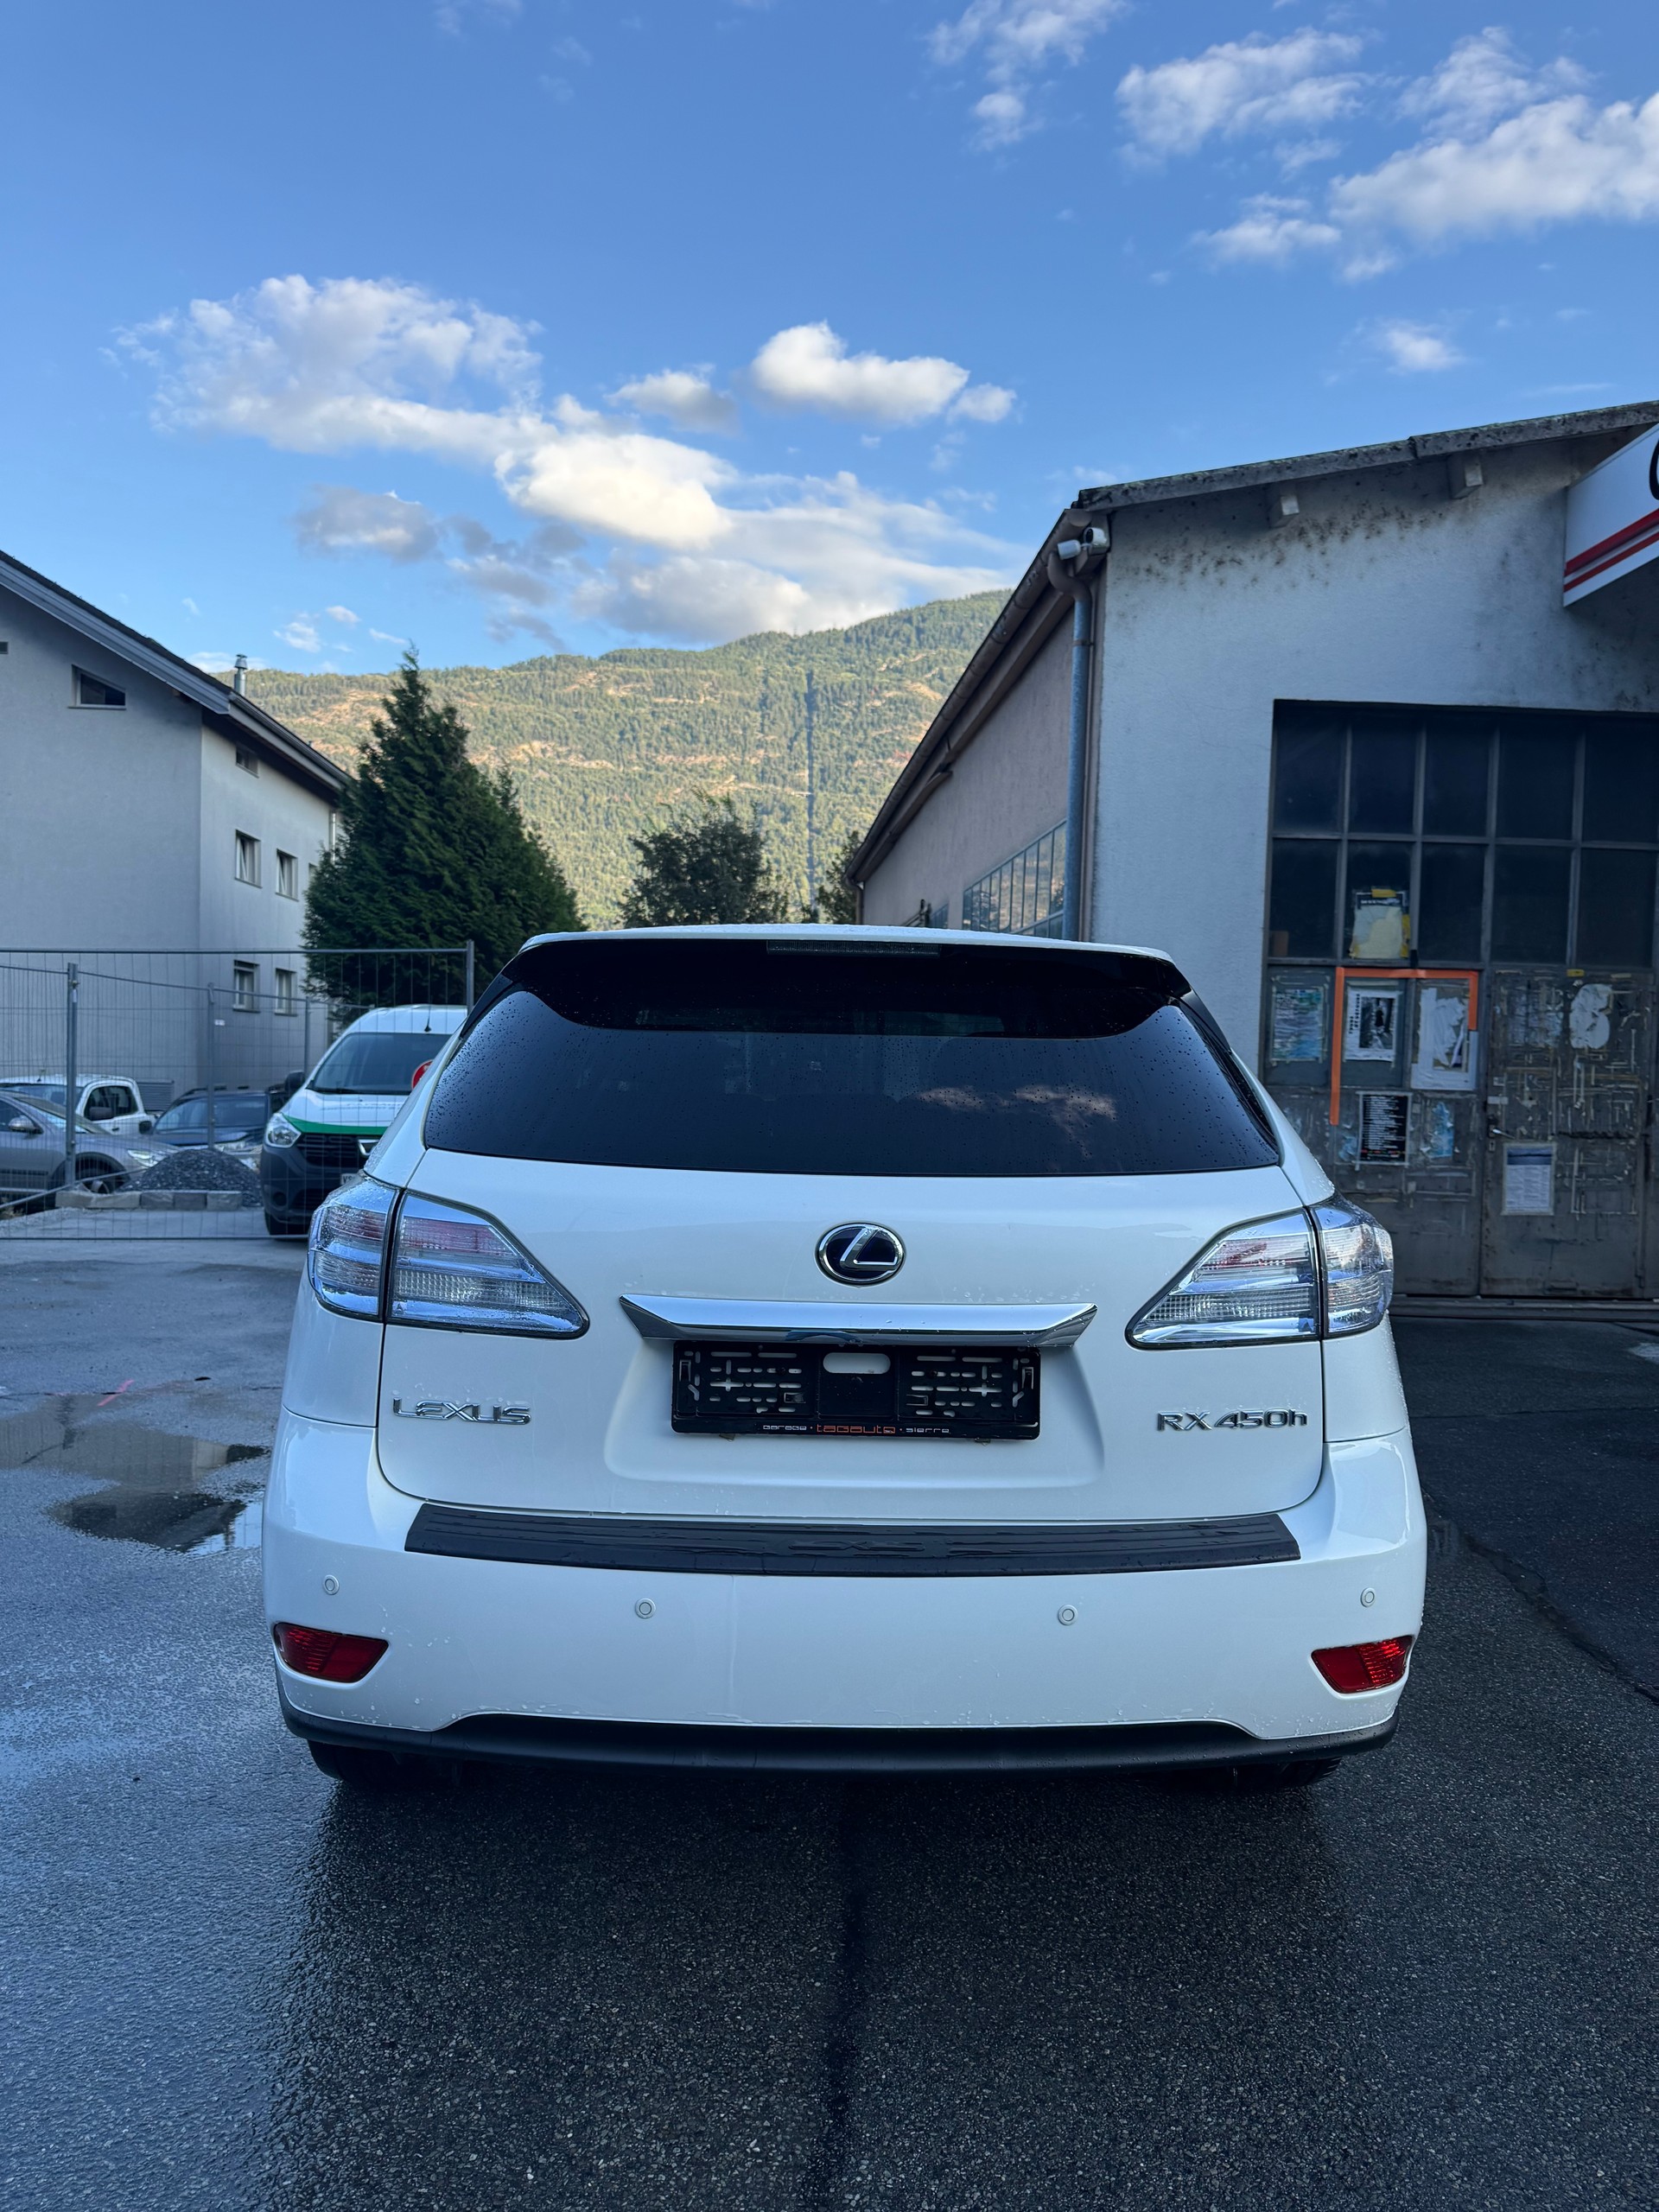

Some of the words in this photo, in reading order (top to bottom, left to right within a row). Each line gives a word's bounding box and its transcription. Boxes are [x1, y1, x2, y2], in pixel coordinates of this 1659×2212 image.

[393, 1397, 531, 1425] LEXUS
[1157, 1410, 1212, 1431] RX
[1213, 1408, 1308, 1430] 450h
